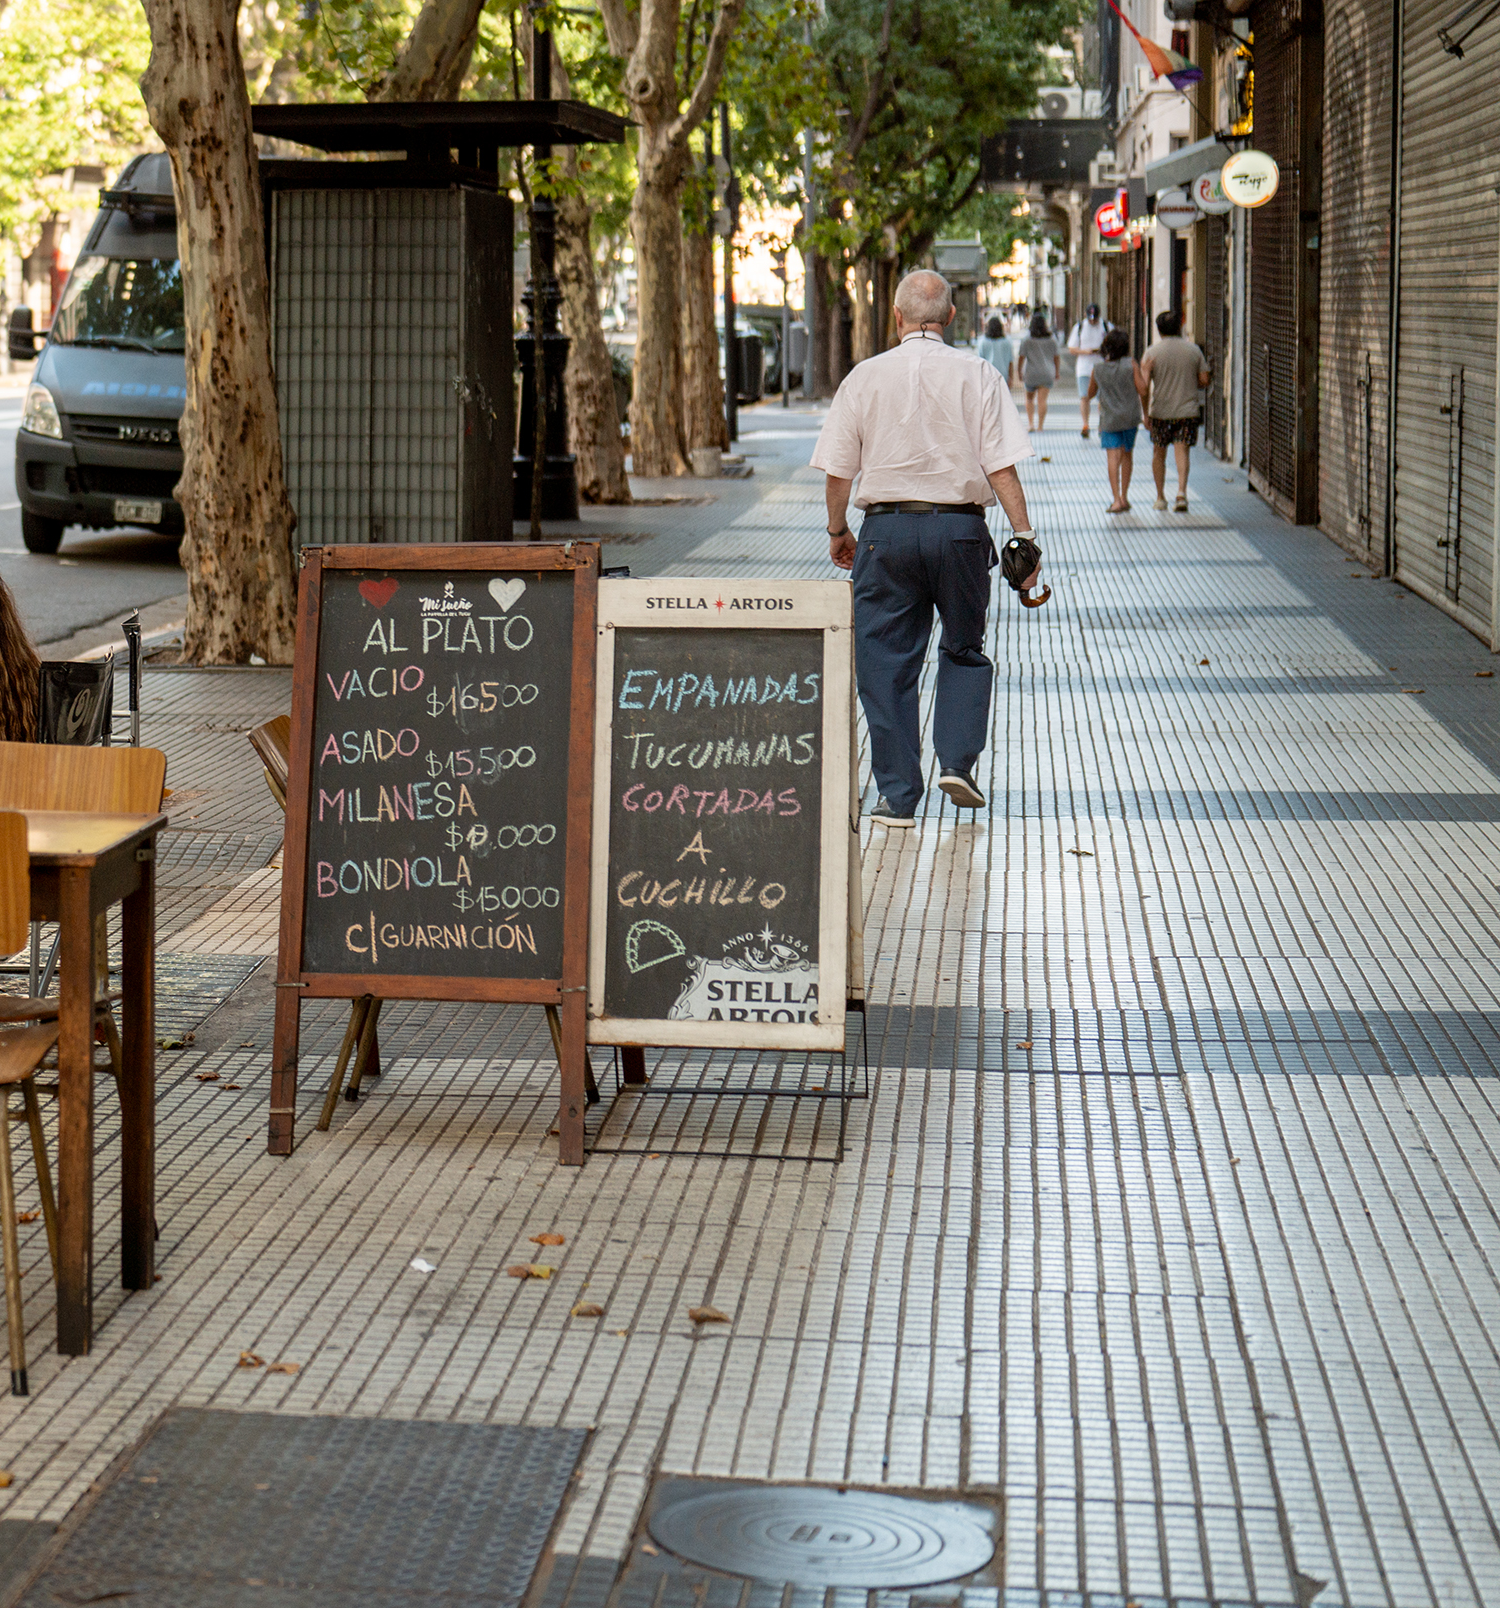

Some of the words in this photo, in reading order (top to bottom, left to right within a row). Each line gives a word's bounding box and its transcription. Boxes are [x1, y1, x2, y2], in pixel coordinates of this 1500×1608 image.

[118, 425, 173, 442] IVECO
[418, 596, 441, 612] Mi
[439, 597, 474, 612] sueño
[646, 597, 708, 610] STELLA
[729, 598, 794, 611] ARTOIS
[362, 616, 409, 655] AL
[421, 614, 535, 655] PLATO
[326, 665, 426, 701] VACIO
[618, 669, 822, 714] EMPANADAS
[319, 728, 421, 766] ASADO
[424, 745, 537, 778] $15.500
[622, 732, 817, 770] TUCUMANAS
[318, 781, 478, 823] MILANESA
[621, 783, 802, 818] CORTADAS
[675, 829, 713, 866] A
[316, 855, 472, 898] BONDIOLA
[617, 867, 787, 910] CUCHILLO
[721, 932, 754, 953] ANNO
[780, 933, 809, 953] 1366
[706, 980, 819, 1004] STELLA
